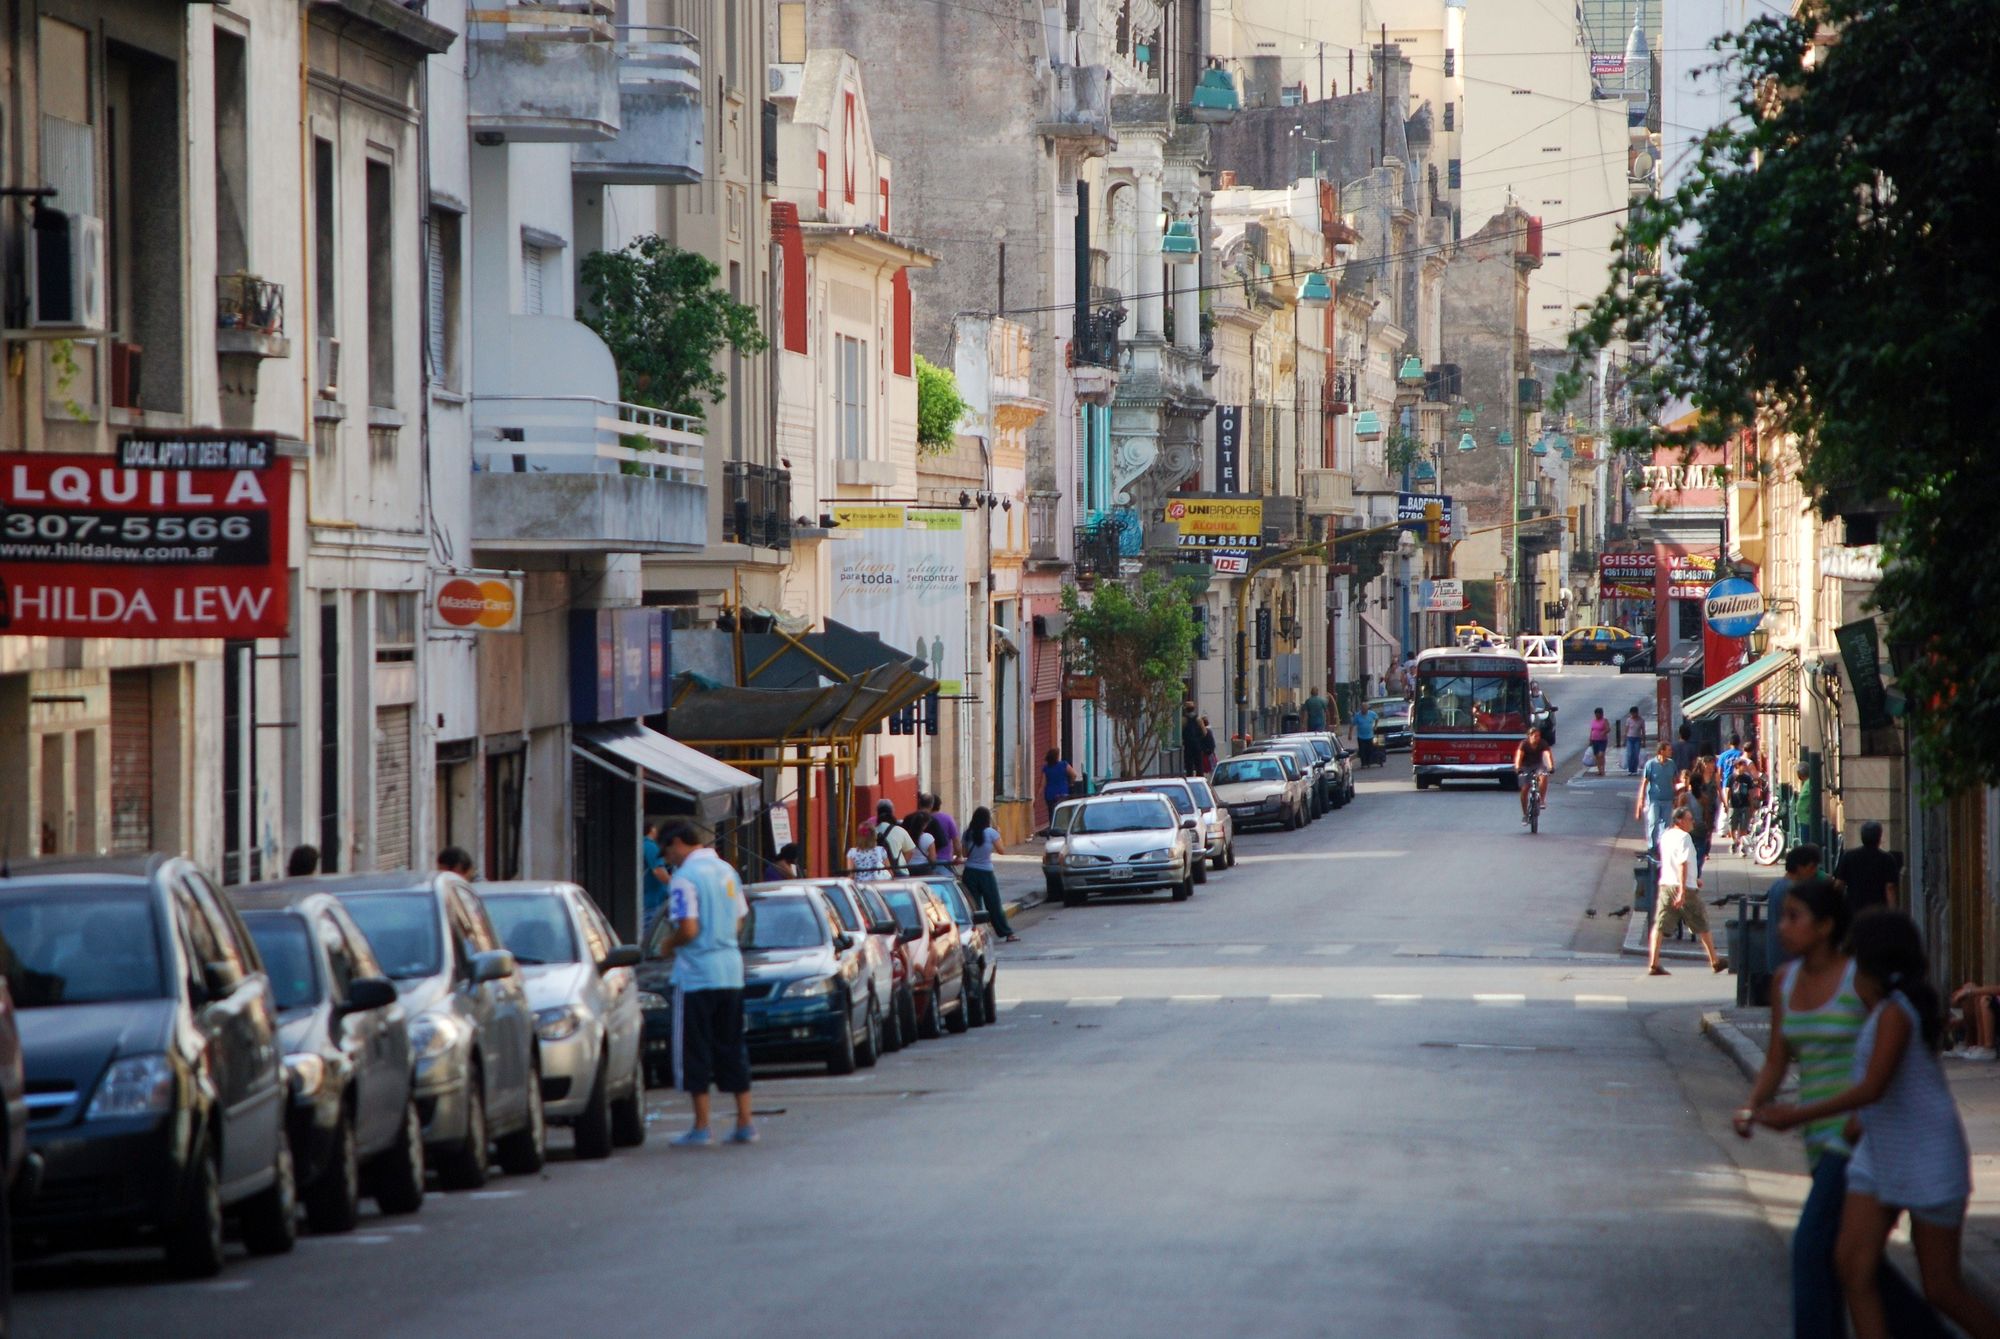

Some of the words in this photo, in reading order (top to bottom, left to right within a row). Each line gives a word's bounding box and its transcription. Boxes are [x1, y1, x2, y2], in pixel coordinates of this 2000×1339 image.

[1223, 405, 1234, 493] HOSTEL
[13, 465, 268, 504] LQUILA
[1187, 504, 1261, 515] UNIBROKERS
[5, 513, 251, 542] 307-5566
[1193, 521, 1238, 530] ALQUILA
[840, 573, 860, 581] para
[861, 572, 893, 584] toda
[912, 574, 958, 582] encontrar
[13, 585, 157, 623] HILDA
[173, 585, 272, 621] LEW
[1708, 596, 1760, 617] Quilmes
